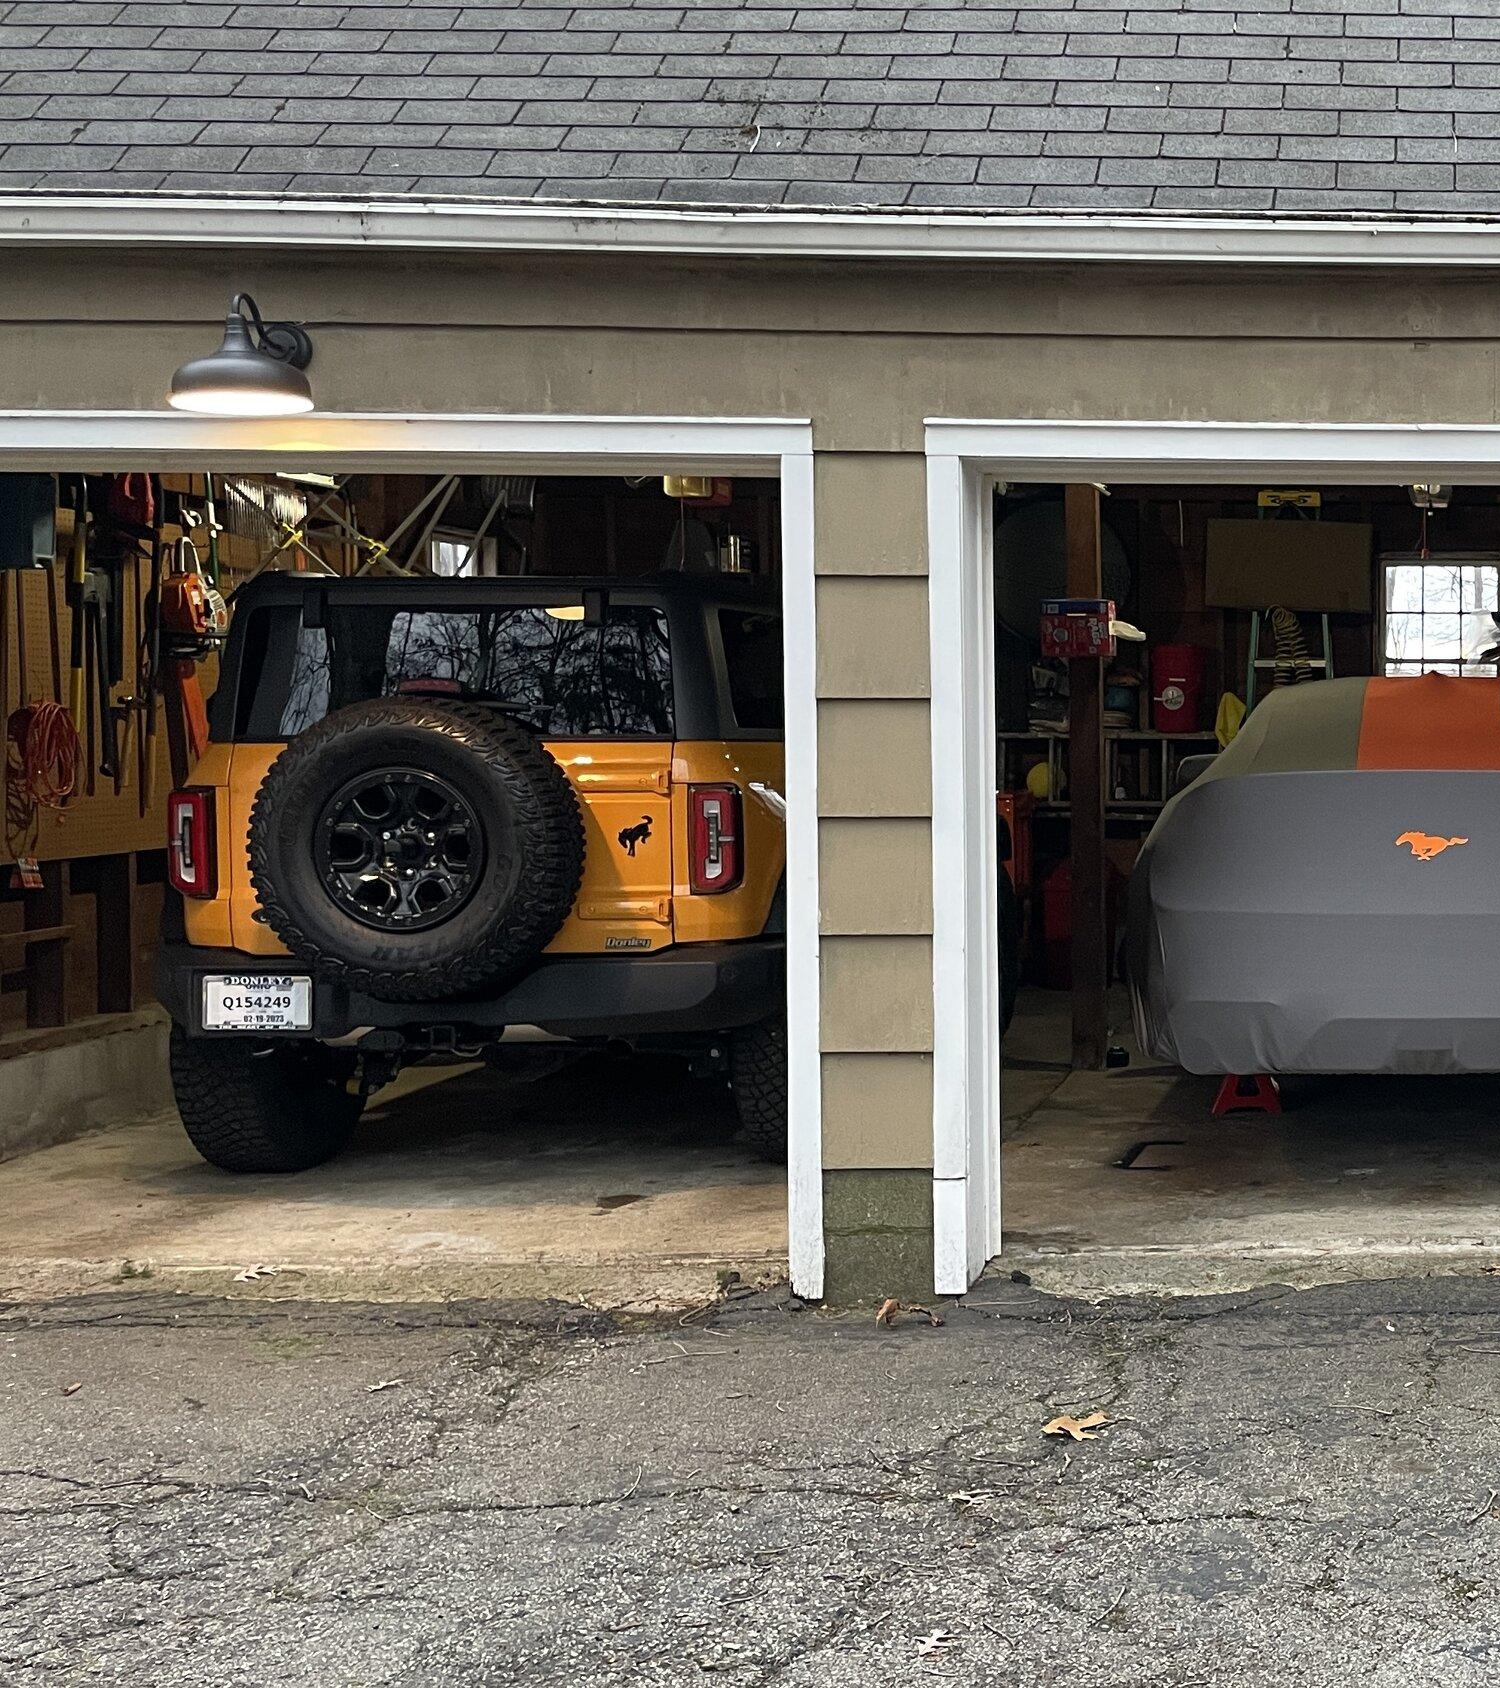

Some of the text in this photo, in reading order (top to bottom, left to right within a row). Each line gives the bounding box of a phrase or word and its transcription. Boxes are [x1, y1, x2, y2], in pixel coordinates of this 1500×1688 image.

[606, 937, 651, 948] Donley
[230, 976, 286, 986] DONLEY
[222, 996, 292, 1010] Q154249
